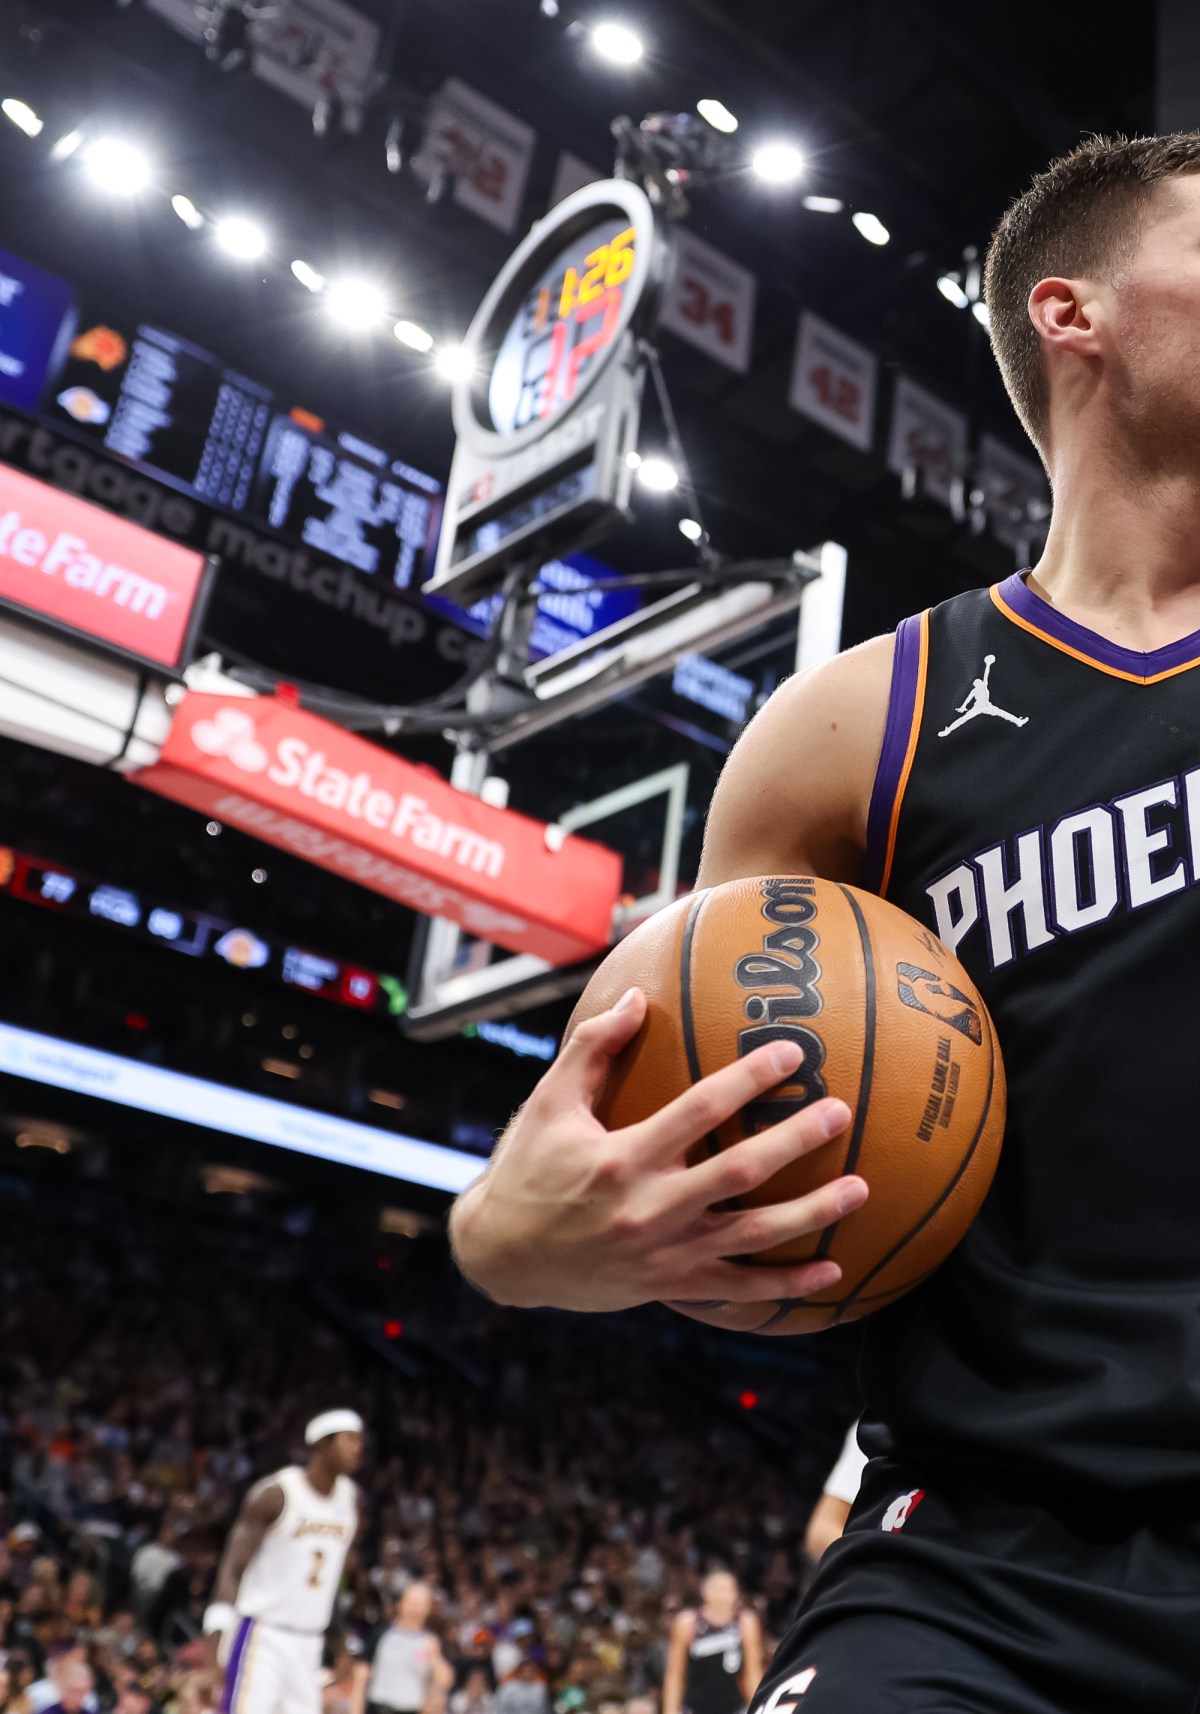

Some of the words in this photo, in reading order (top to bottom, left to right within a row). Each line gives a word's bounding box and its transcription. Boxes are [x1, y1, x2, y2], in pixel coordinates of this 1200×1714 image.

[267, 736, 506, 878] StateFarm
[916, 1093, 942, 1142] OFFICIAL
[931, 1063, 948, 1093] GAME
